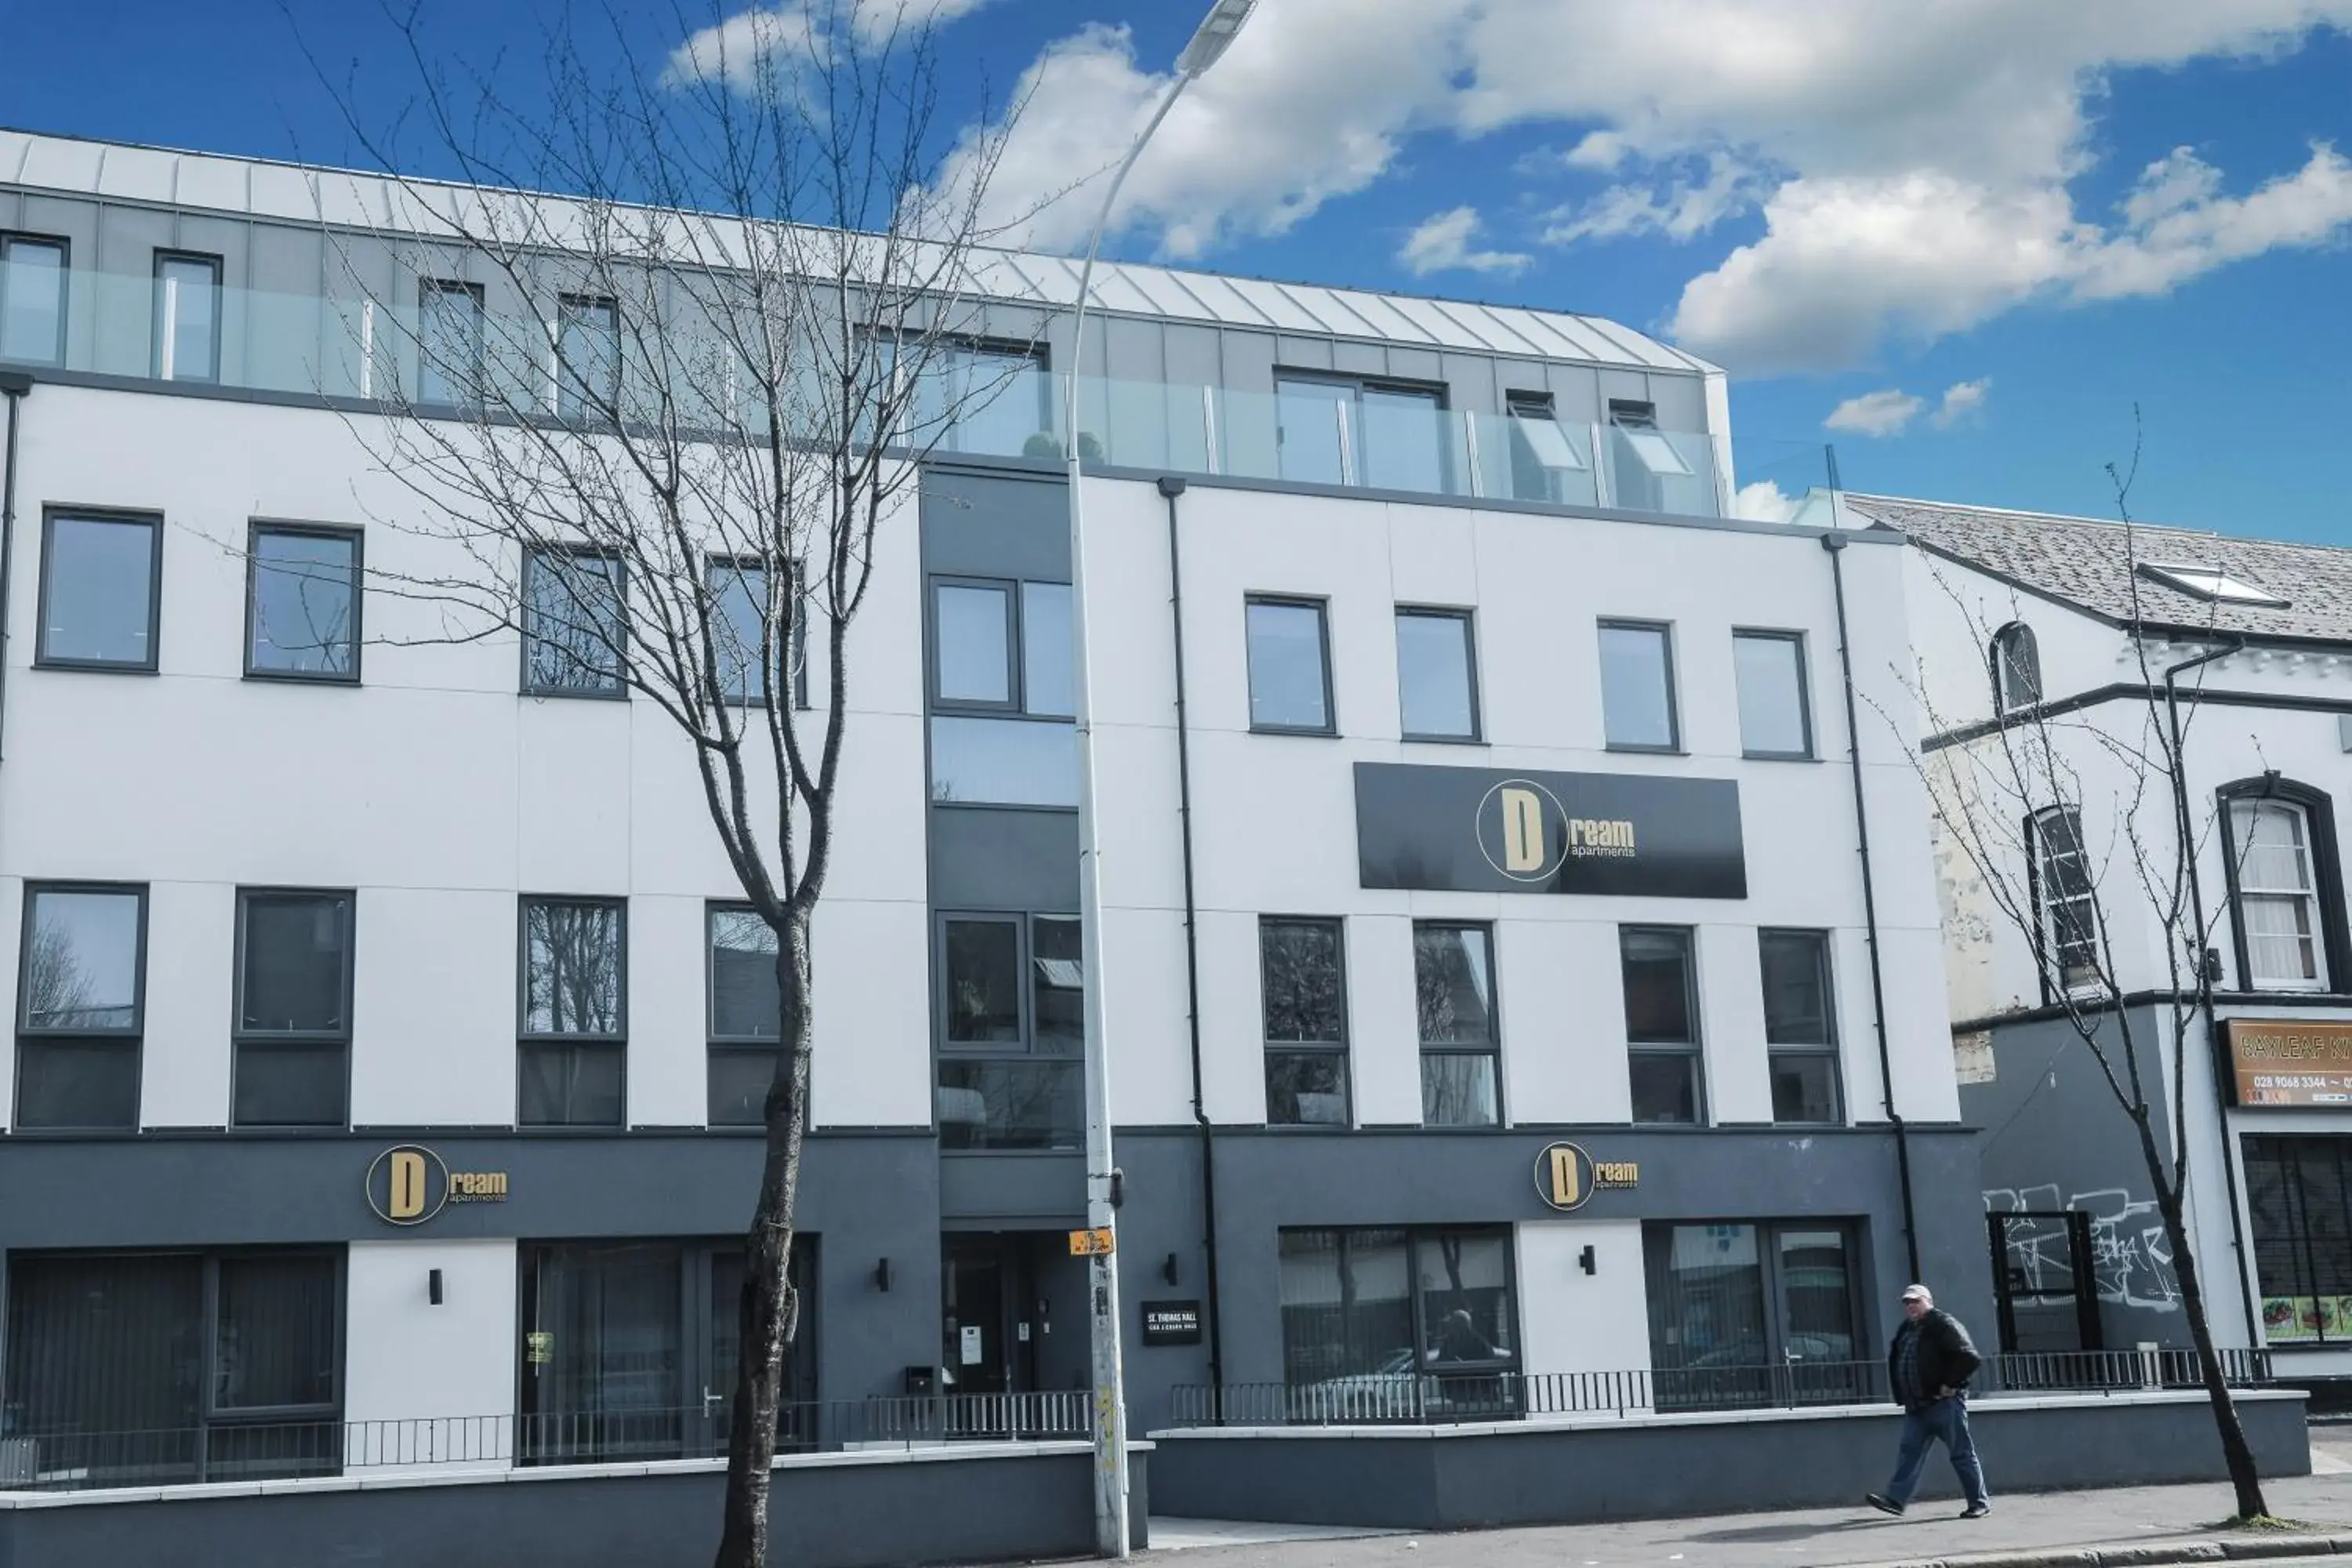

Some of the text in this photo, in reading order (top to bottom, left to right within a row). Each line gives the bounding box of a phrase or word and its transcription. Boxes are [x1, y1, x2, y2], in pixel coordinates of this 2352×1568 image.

[1502, 789, 1635, 871] Dream
[1571, 846, 1635, 858] apartments
[2240, 1035, 2325, 1060] BAYLEAF
[2254, 1076, 2273, 1087] 028
[390, 1152, 506, 1218] Dream
[1551, 1149, 1637, 1204] Dream
[449, 1194, 506, 1203] apartments
